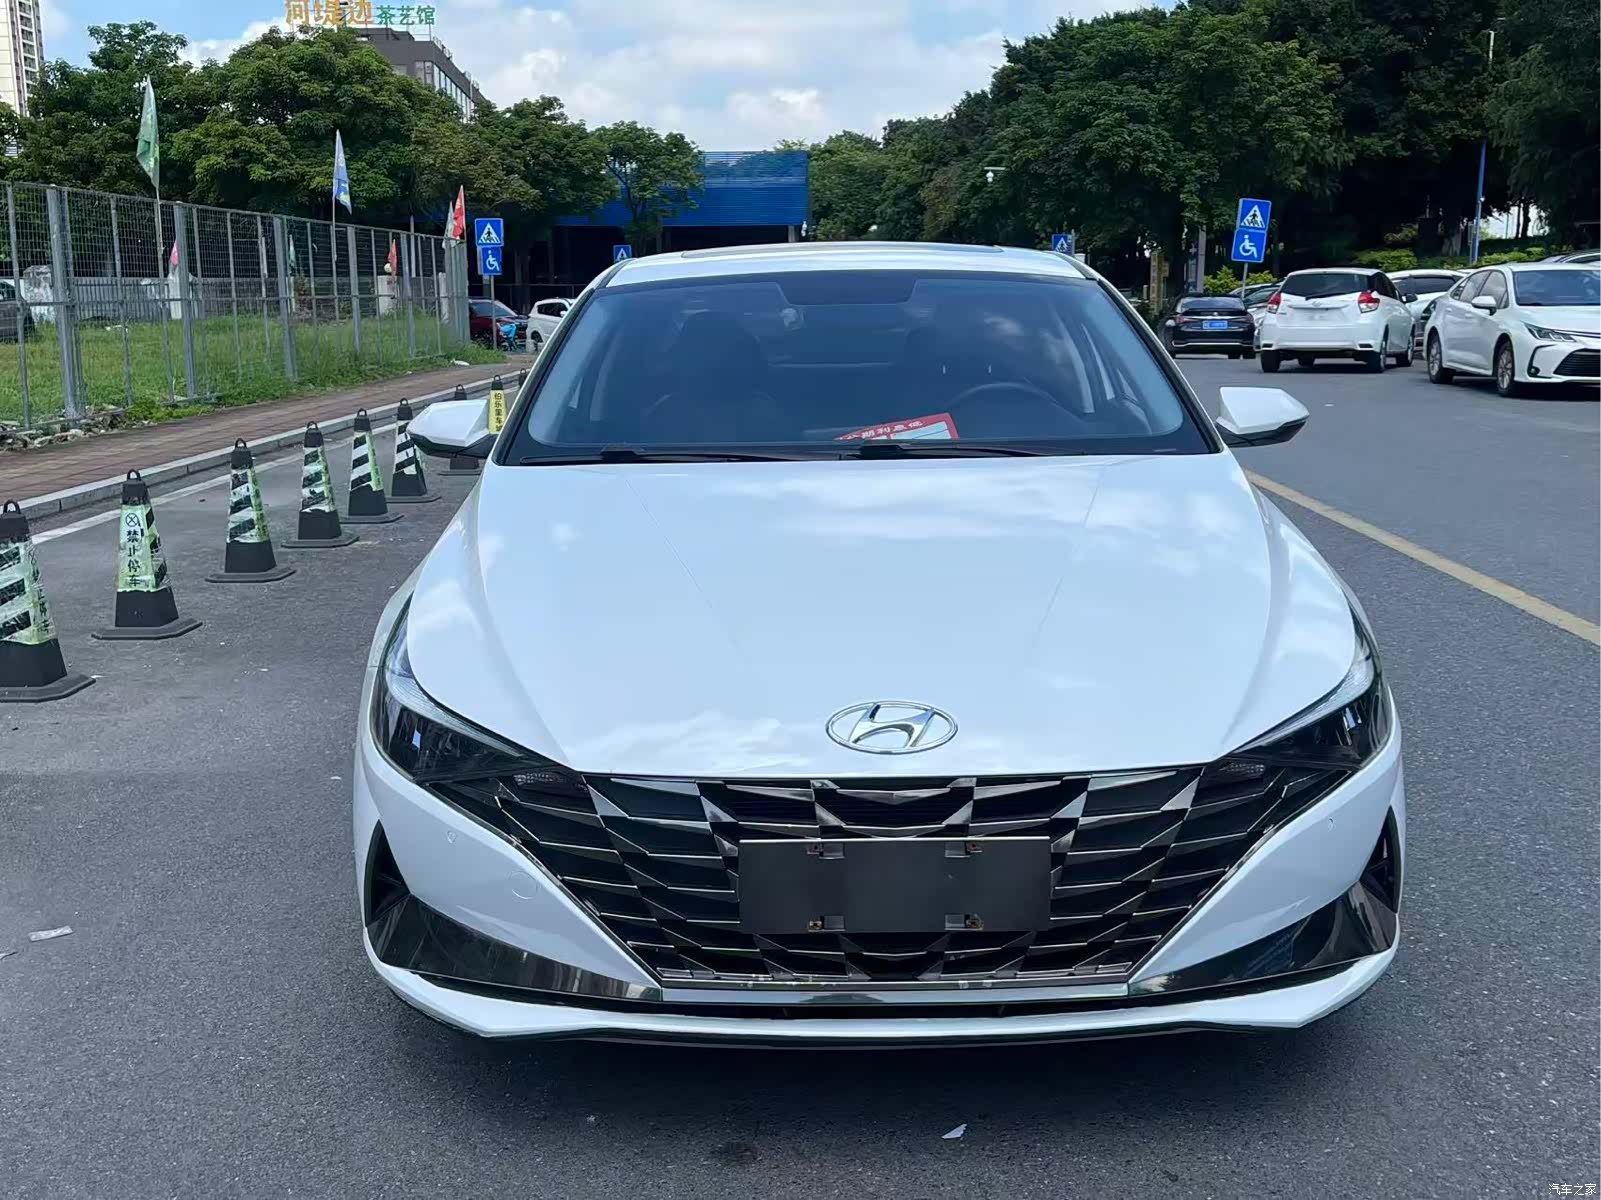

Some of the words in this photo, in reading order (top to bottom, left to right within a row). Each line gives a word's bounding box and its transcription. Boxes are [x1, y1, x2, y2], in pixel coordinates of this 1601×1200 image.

[376, 5, 436, 25] 茶艺馆
[126, 529, 140, 587] 禁止停车
